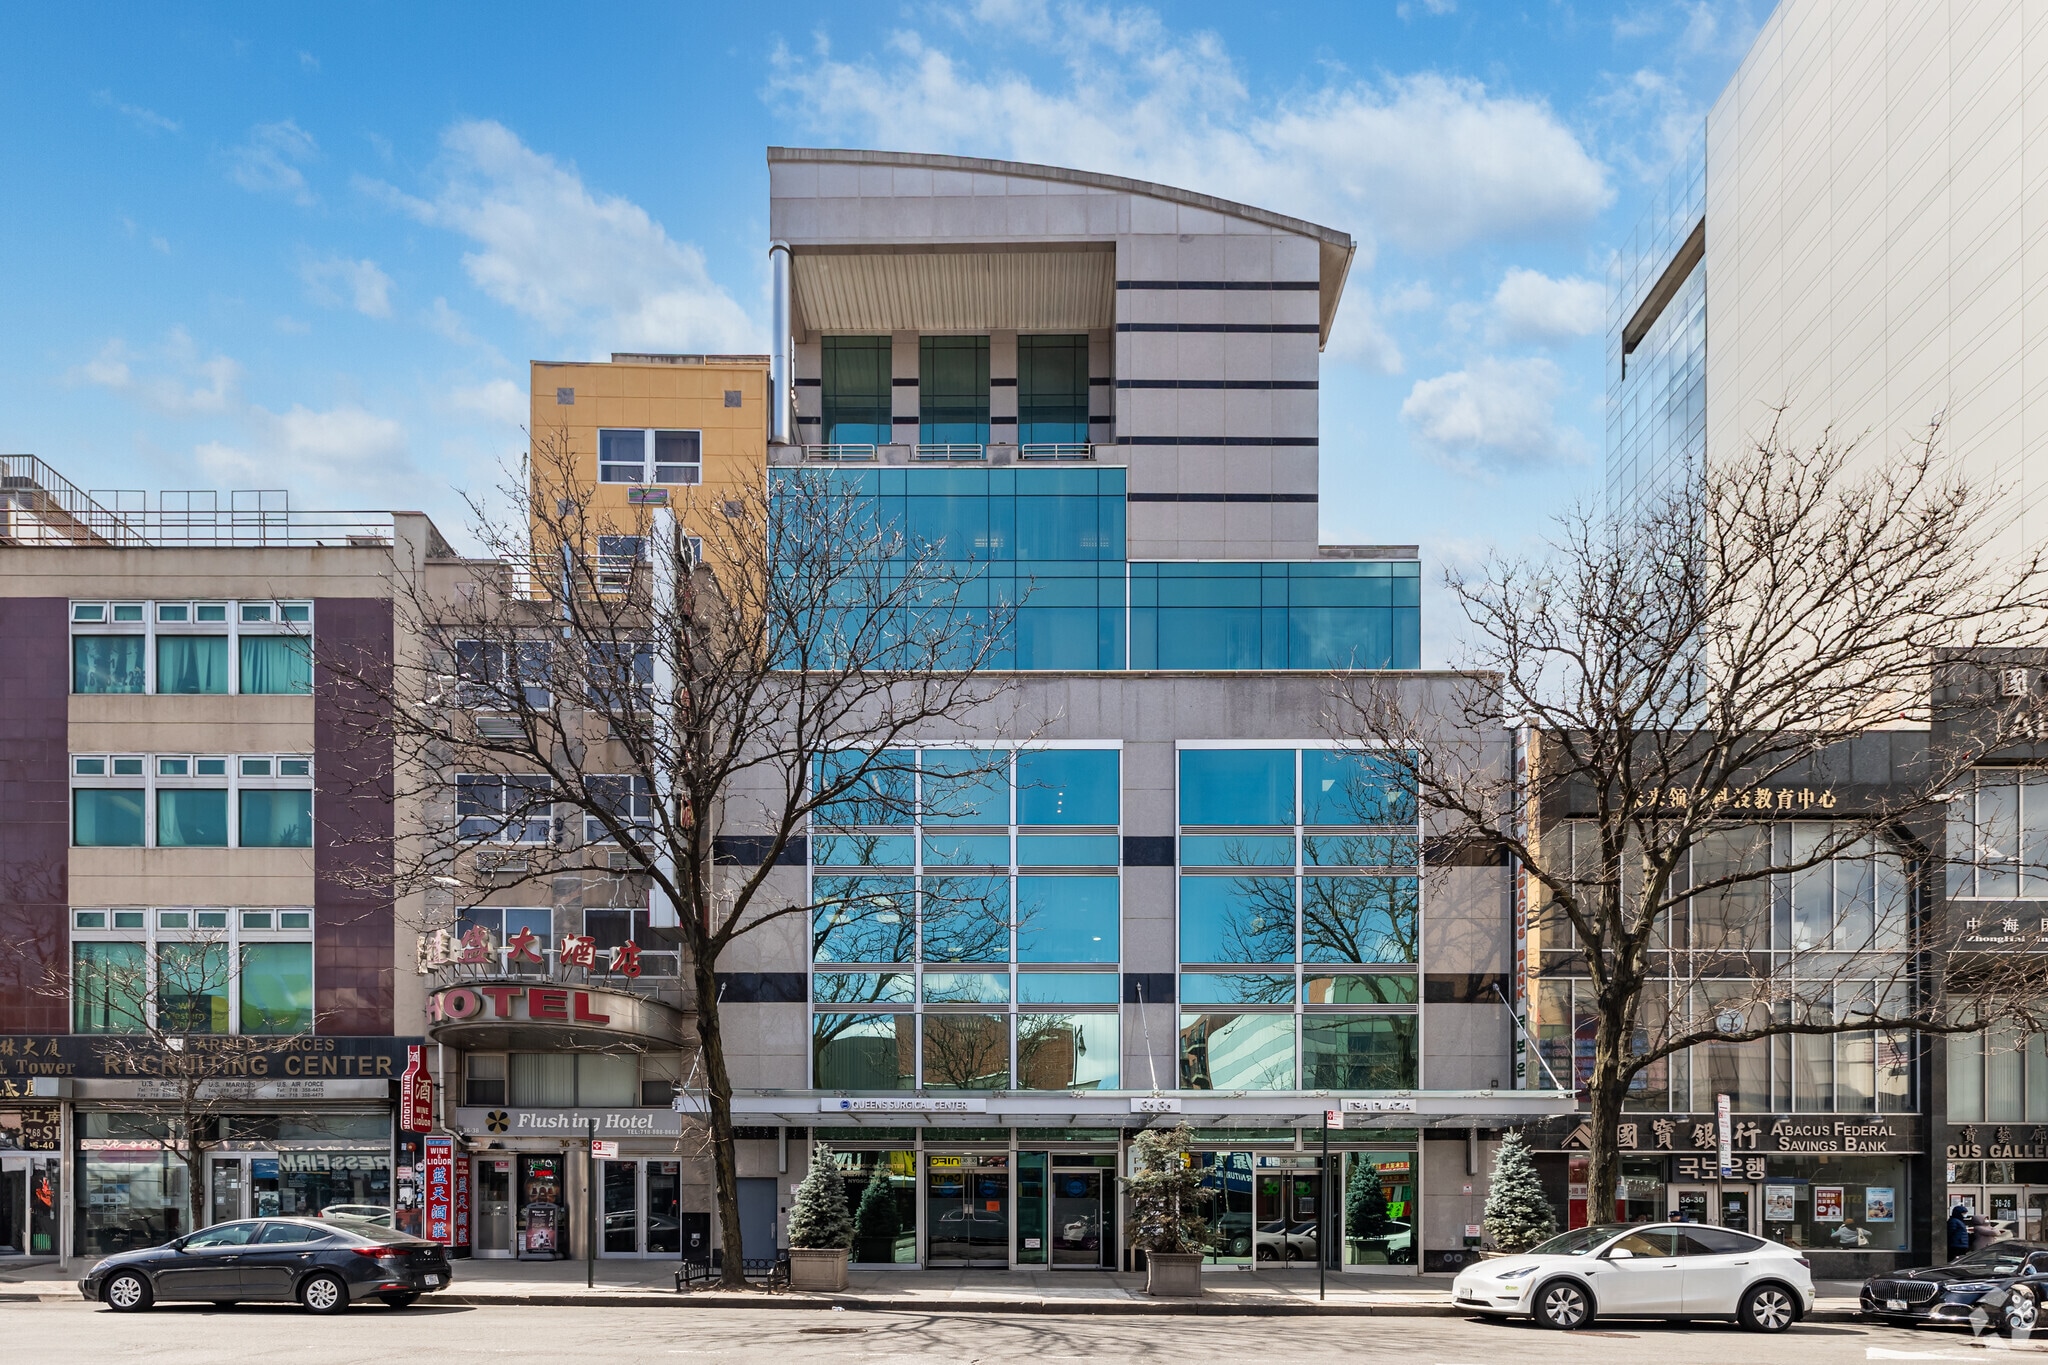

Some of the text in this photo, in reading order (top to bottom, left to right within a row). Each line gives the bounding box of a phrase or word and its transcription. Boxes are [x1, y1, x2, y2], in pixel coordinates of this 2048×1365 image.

[1634, 788, 1837, 809] 來領科技教育中心
[1516, 864, 1526, 999] ABACUS BANK
[425, 987, 610, 1024] HOTEL
[165, 1012, 206, 1020] Westrn
[197, 1038, 335, 1052] ARMED FORCES
[16, 1059, 76, 1075] Tower
[104, 1055, 393, 1076] RECRUITING CENTER
[403, 1074, 411, 1095] WINE
[416, 1076, 432, 1103] 酒
[416, 1106, 429, 1115] WINE
[852, 1101, 968, 1111] QUEENS SURGICAL CENTER
[1371, 1101, 1411, 1110] PLAZA
[403, 1102, 411, 1130] LIQUOR
[414, 1118, 431, 1127] LIQUOR
[517, 1113, 654, 1132] Flushing Hotel
[1617, 1118, 1762, 1150] 國寶銀行
[1770, 1121, 1896, 1136] ABACUS FEDERAL
[430, 1147, 449, 1155] WINE
[559, 1139, 570, 1148] 36
[1778, 1136, 1887, 1151] SAVINGS BANK
[1946, 1144, 2048, 1158] CUS GALLE
[1678, 1157, 1766, 1180] 국보은행
[1680, 1196, 1705, 1204] 36-30
